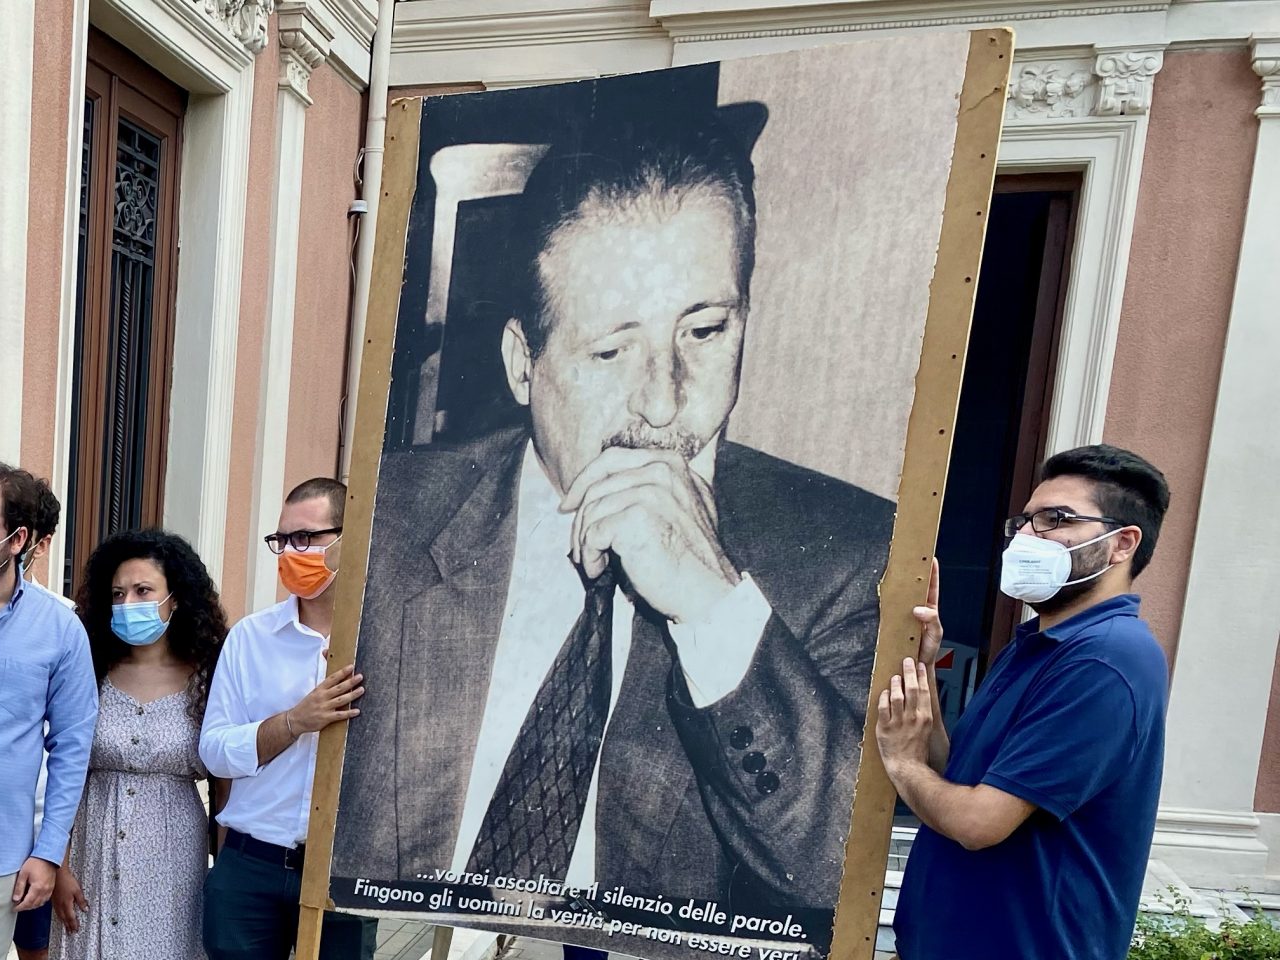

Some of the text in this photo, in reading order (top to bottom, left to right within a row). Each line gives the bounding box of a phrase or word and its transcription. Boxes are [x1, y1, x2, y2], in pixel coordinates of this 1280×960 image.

[353, 878, 425, 905] Fingono
[429, 886, 454, 911] gli
[457, 896, 521, 917] uomini
[526, 901, 545, 920] la
[550, 905, 604, 929] verità
[608, 917, 643, 937] per
[646, 926, 683, 946] non
[687, 933, 752, 959] essere
[494, 874, 581, 900] ascoltare
[585, 881, 600, 901] il
[602, 886, 674, 915] silenzio
[678, 899, 728, 925] delle
[730, 914, 809, 940] parole.
